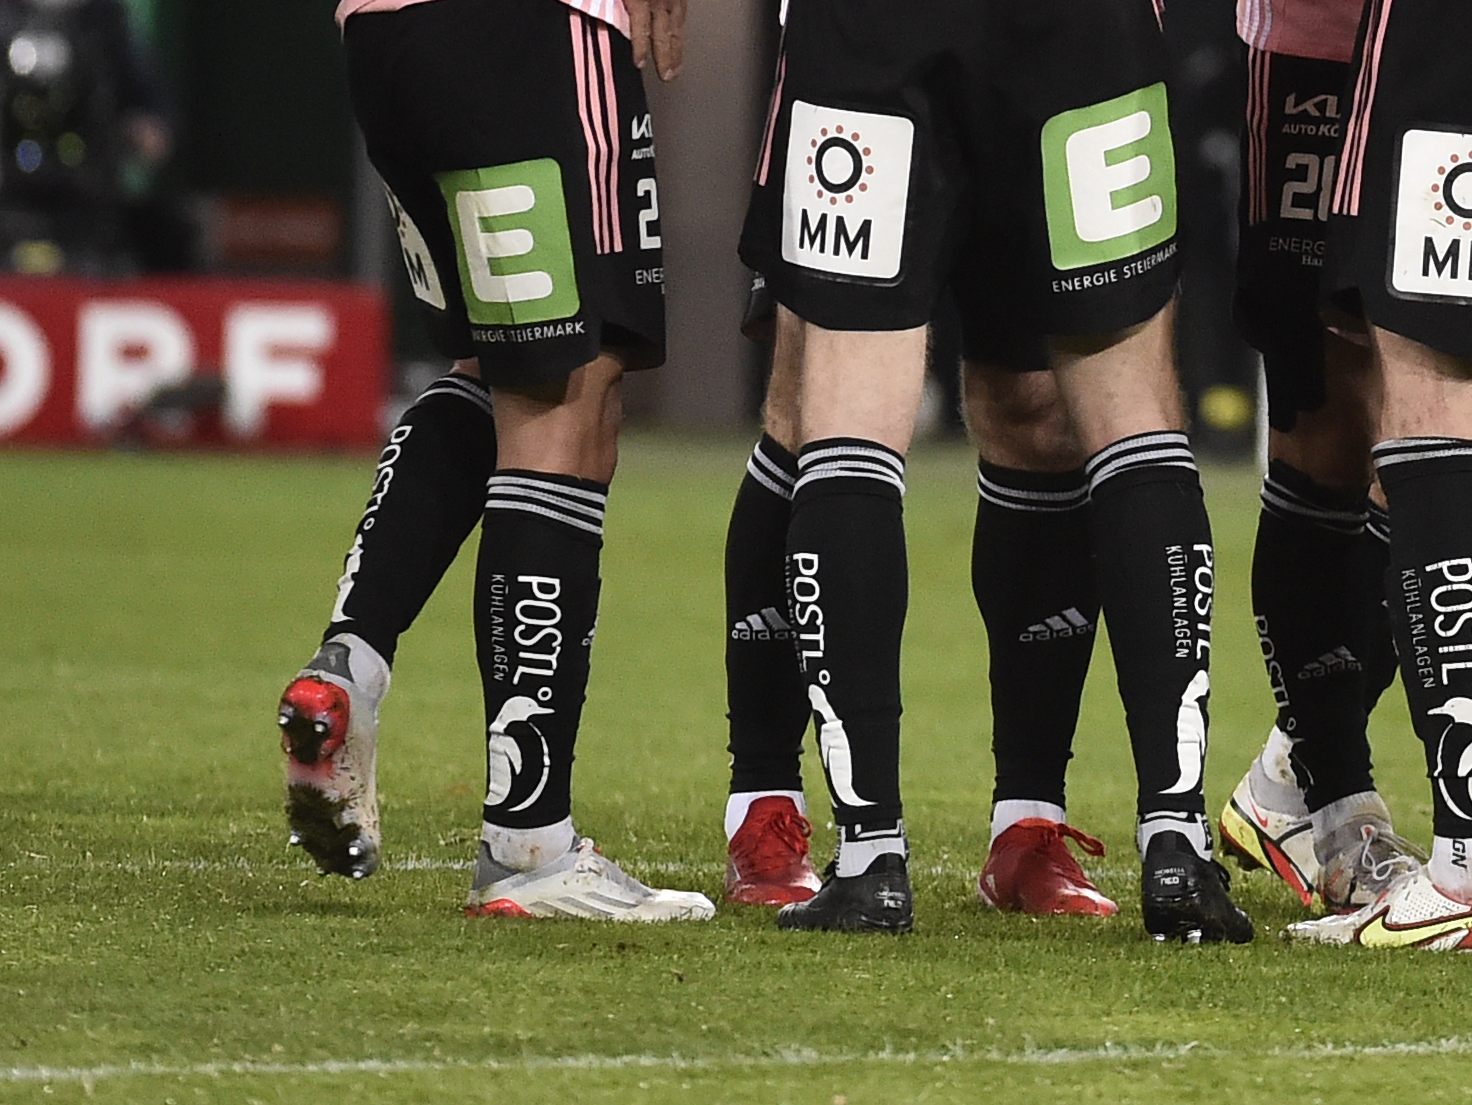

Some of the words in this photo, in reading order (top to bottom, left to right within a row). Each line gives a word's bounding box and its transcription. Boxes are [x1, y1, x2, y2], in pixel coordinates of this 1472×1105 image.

[1066, 111, 1163, 242] E
[456, 184, 553, 303] E
[636, 178, 662, 250] 2
[799, 208, 873, 261] MM
[1052, 270, 1118, 293] ENERGIE
